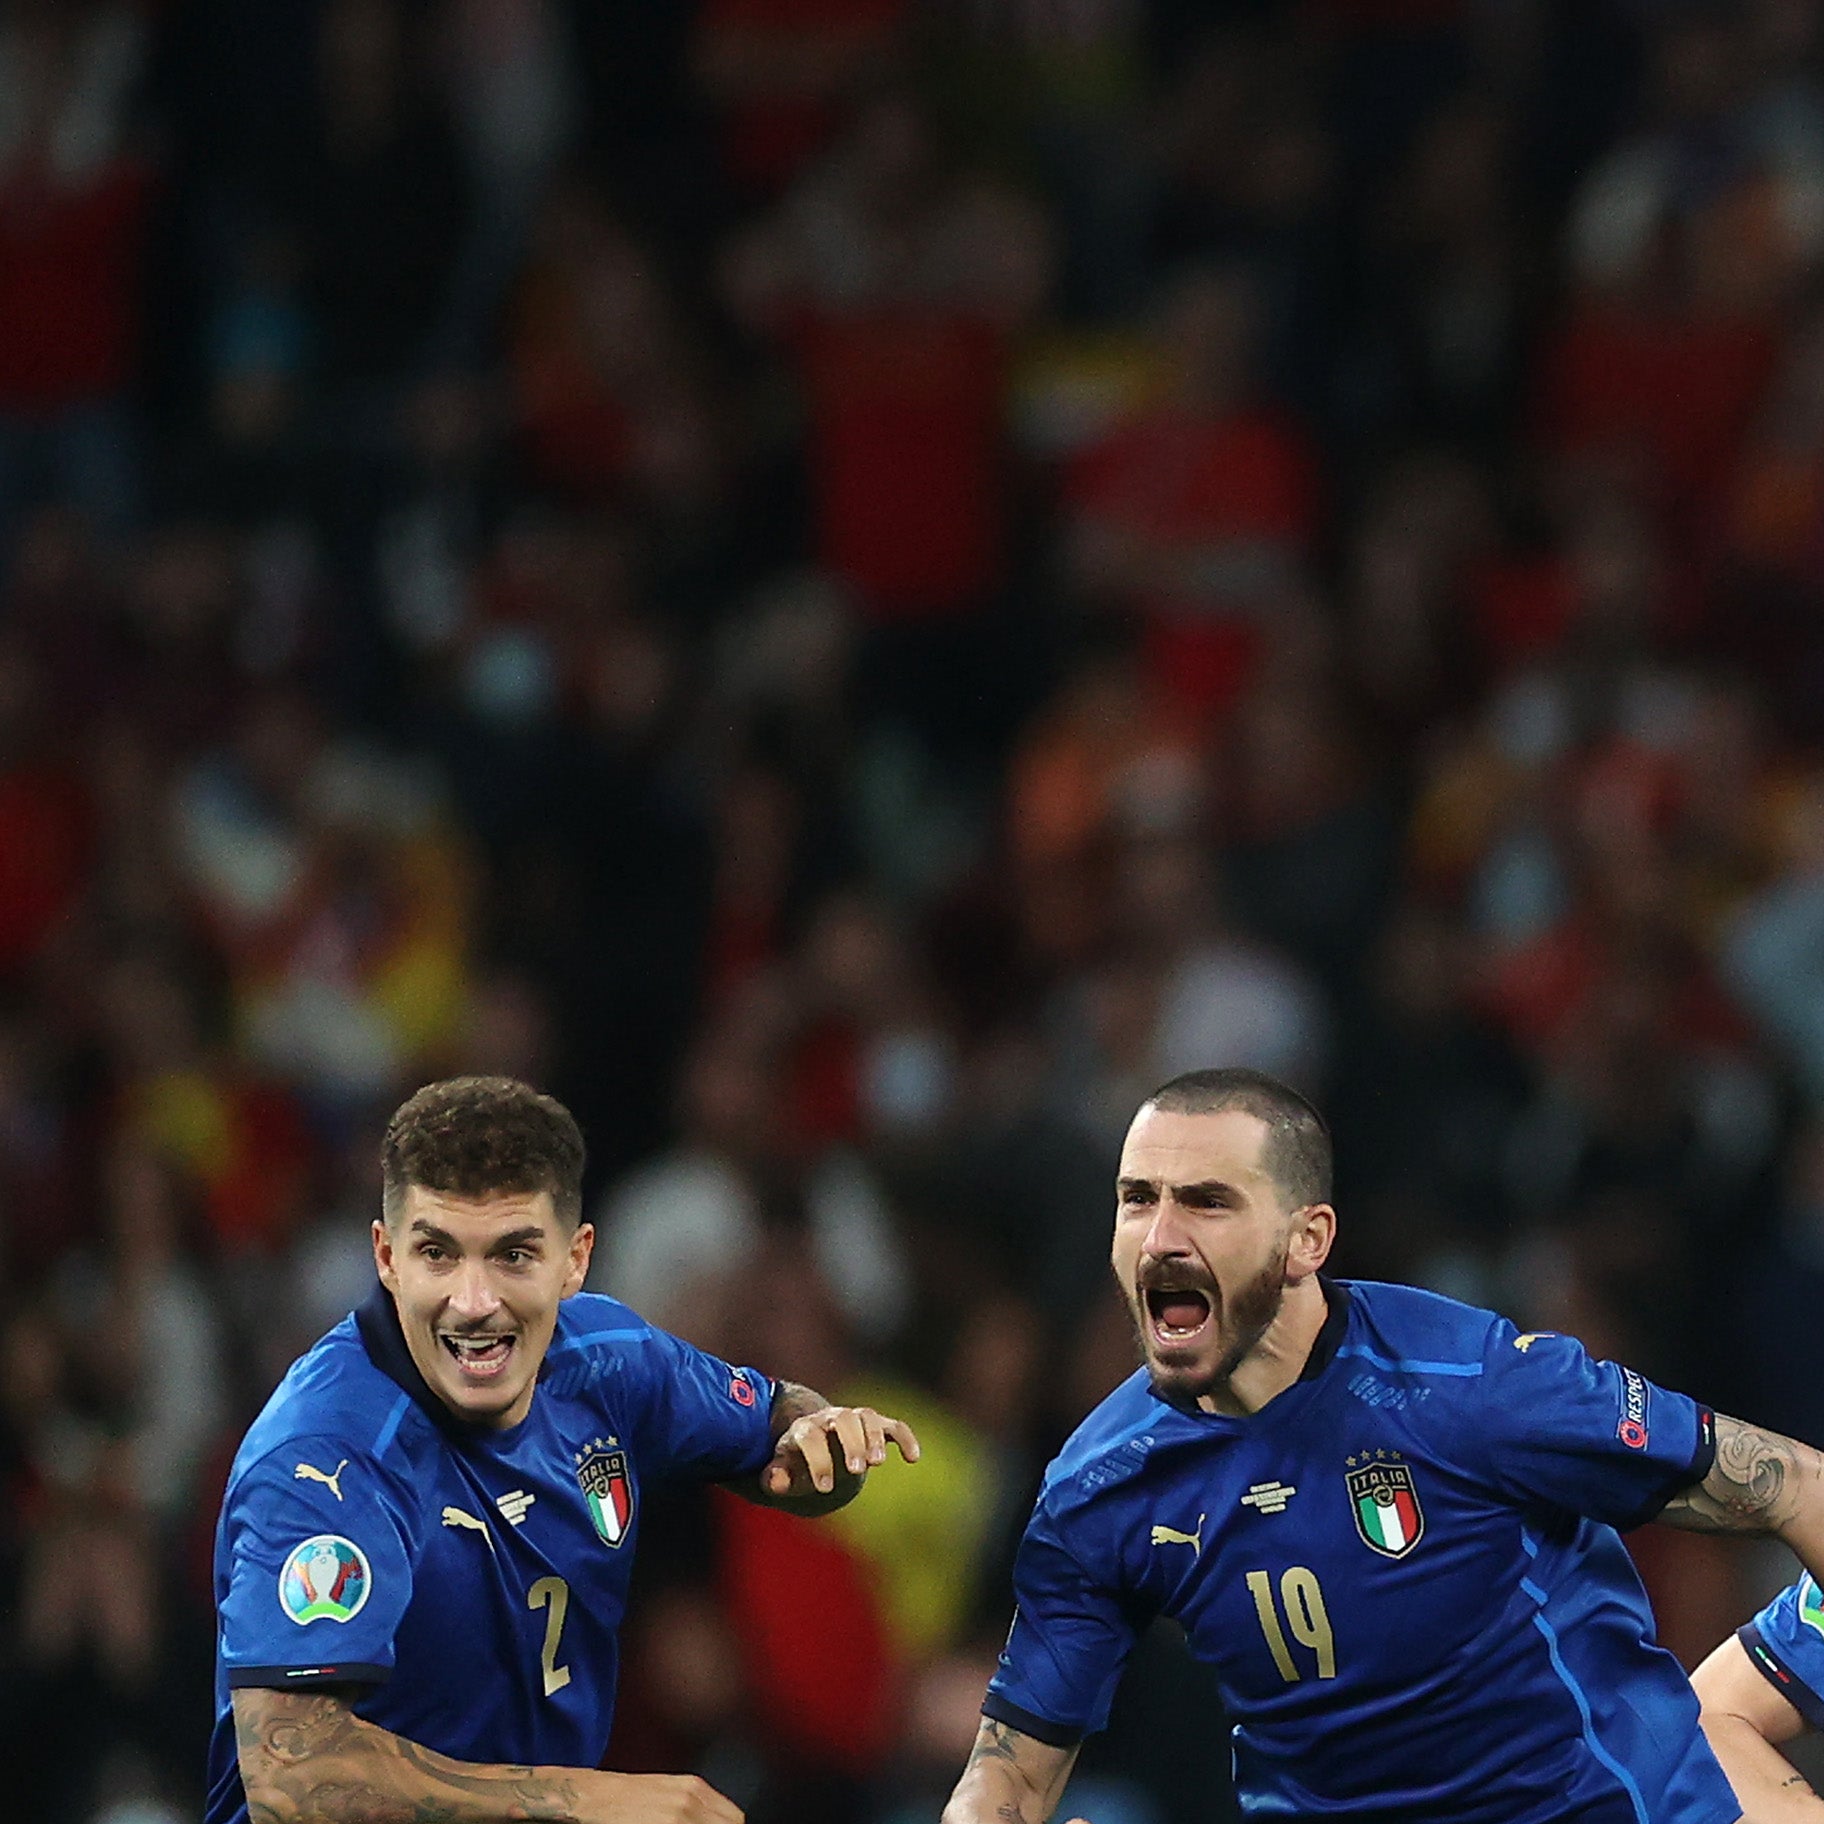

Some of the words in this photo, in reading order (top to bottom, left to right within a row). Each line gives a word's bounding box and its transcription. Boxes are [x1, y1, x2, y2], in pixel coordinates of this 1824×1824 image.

[579, 1457, 620, 1488] ITALIA
[1354, 1470, 1406, 1491] ITALIA
[528, 1576, 571, 1696] 2
[1246, 1566, 1336, 1681] 19
